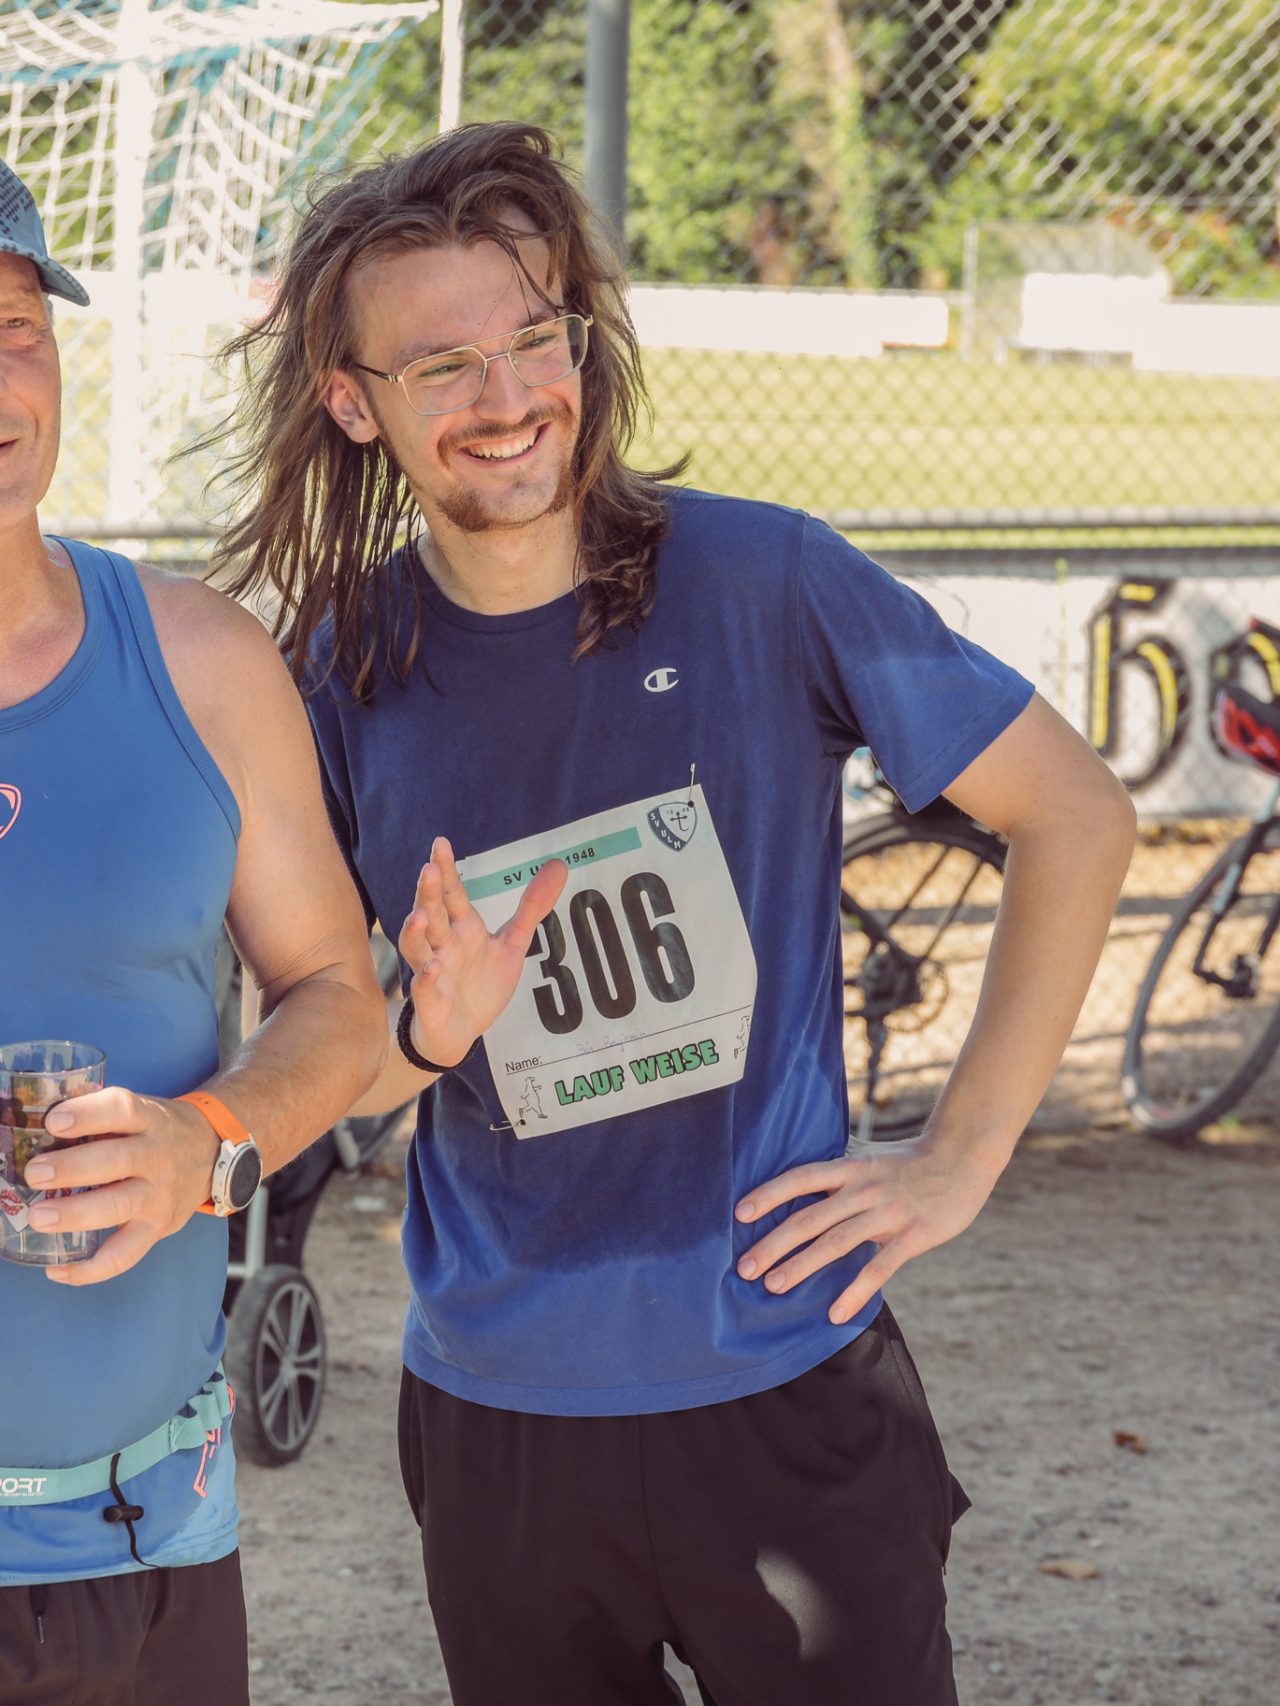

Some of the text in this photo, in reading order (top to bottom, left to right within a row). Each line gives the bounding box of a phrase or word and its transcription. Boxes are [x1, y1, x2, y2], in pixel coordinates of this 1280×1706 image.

[503, 847, 596, 886] SV 1948
[524, 871, 696, 1035] 306
[505, 1056, 543, 1074] Name:
[553, 1038, 720, 1106] LAUF WEISE
